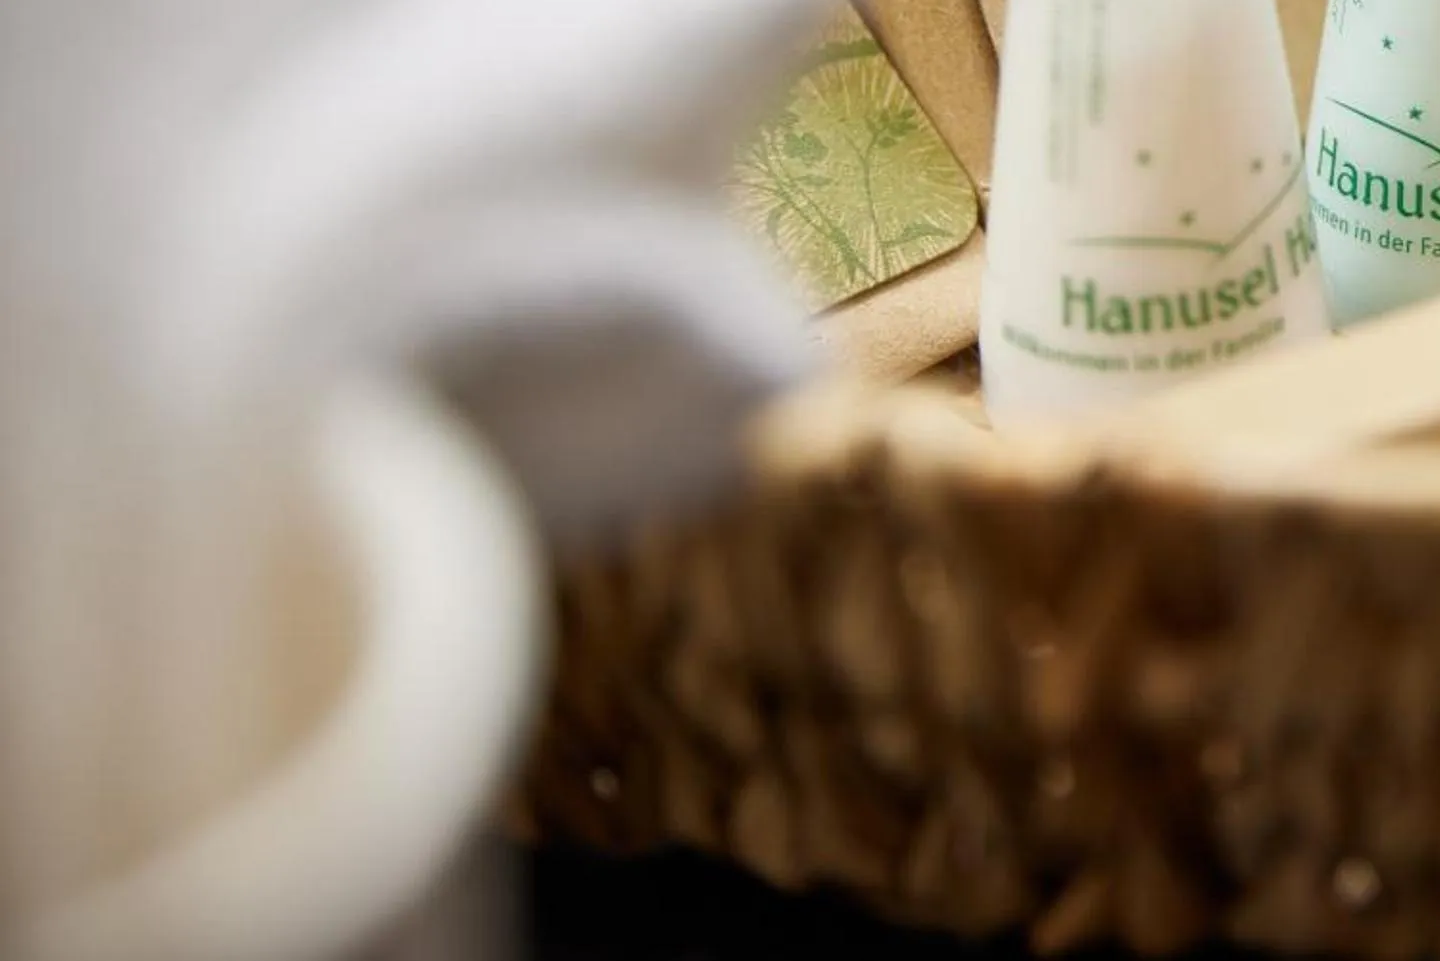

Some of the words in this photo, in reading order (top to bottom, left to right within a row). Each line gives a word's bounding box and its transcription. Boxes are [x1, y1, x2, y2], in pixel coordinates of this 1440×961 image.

[1353, 220, 1372, 244] in
[1378, 230, 1413, 255] der
[1060, 242, 1280, 334] Hanusel
